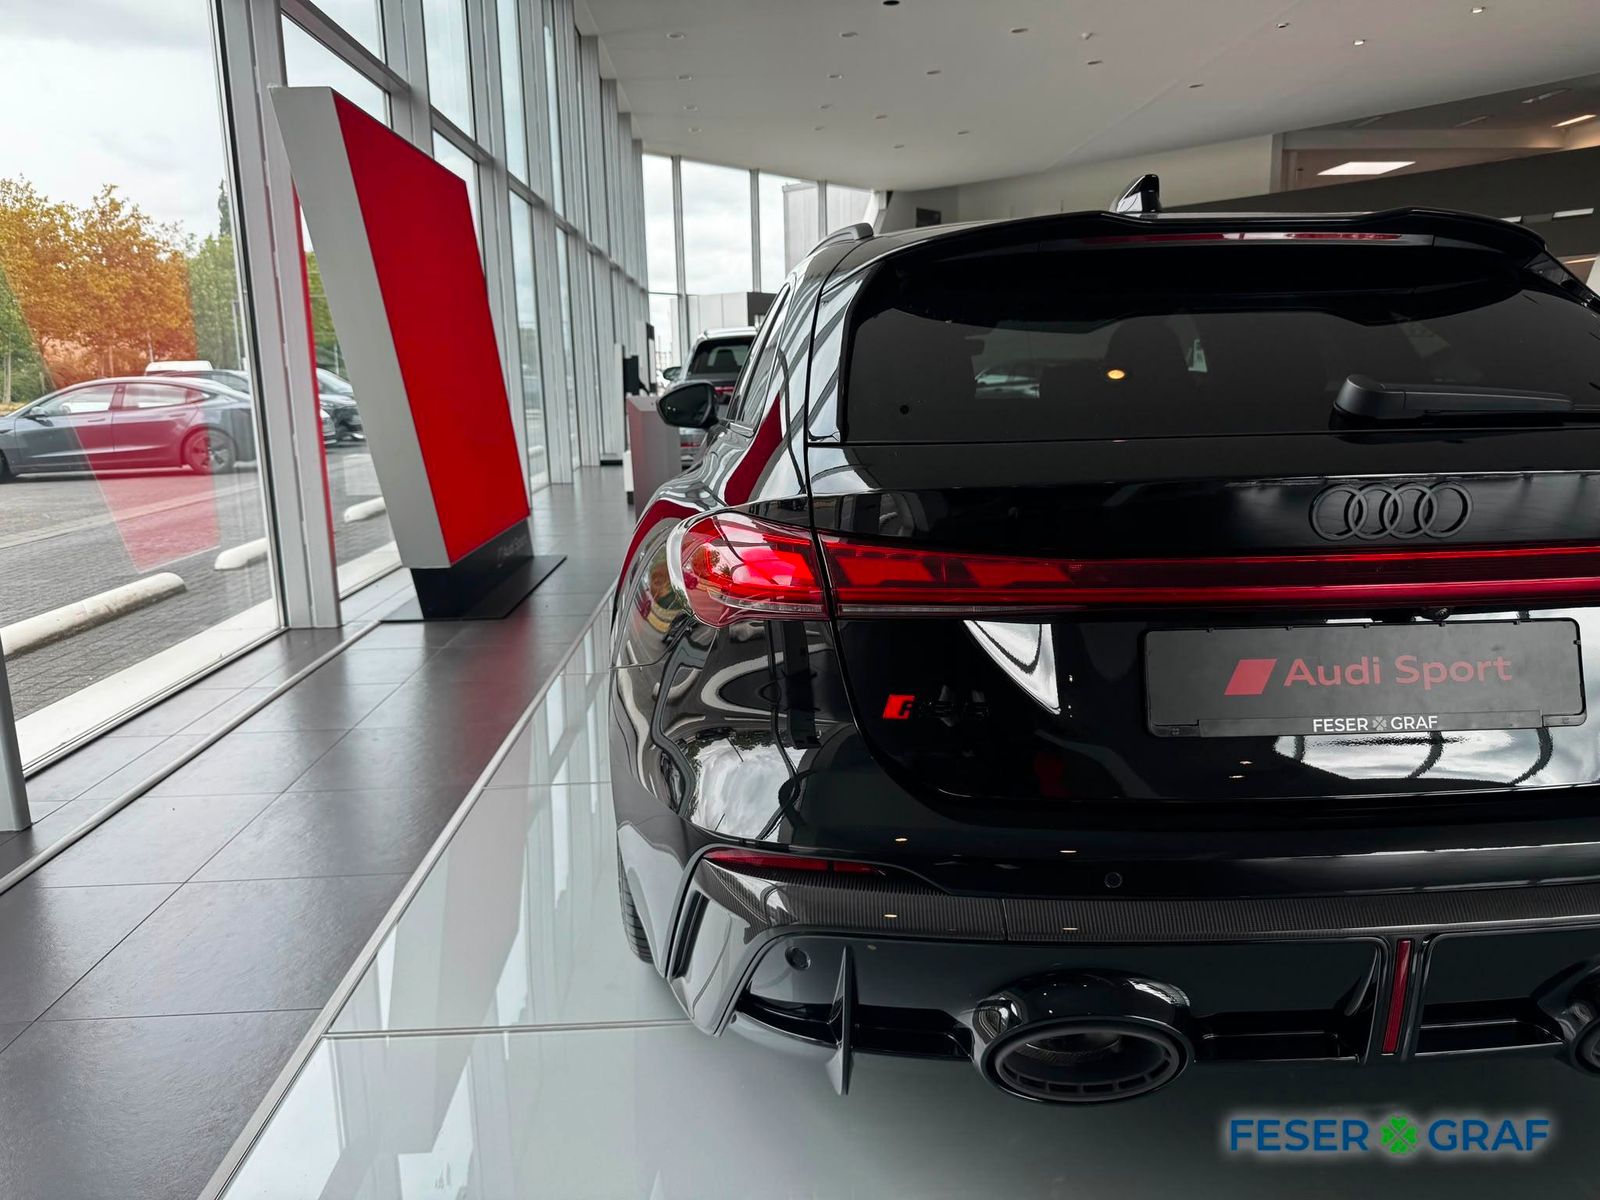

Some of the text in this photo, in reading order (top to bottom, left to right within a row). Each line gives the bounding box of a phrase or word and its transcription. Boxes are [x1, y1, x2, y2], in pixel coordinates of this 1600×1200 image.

[1283, 655, 1513, 690] Audi Sport
[1312, 715, 1438, 732] FESER GRAF
